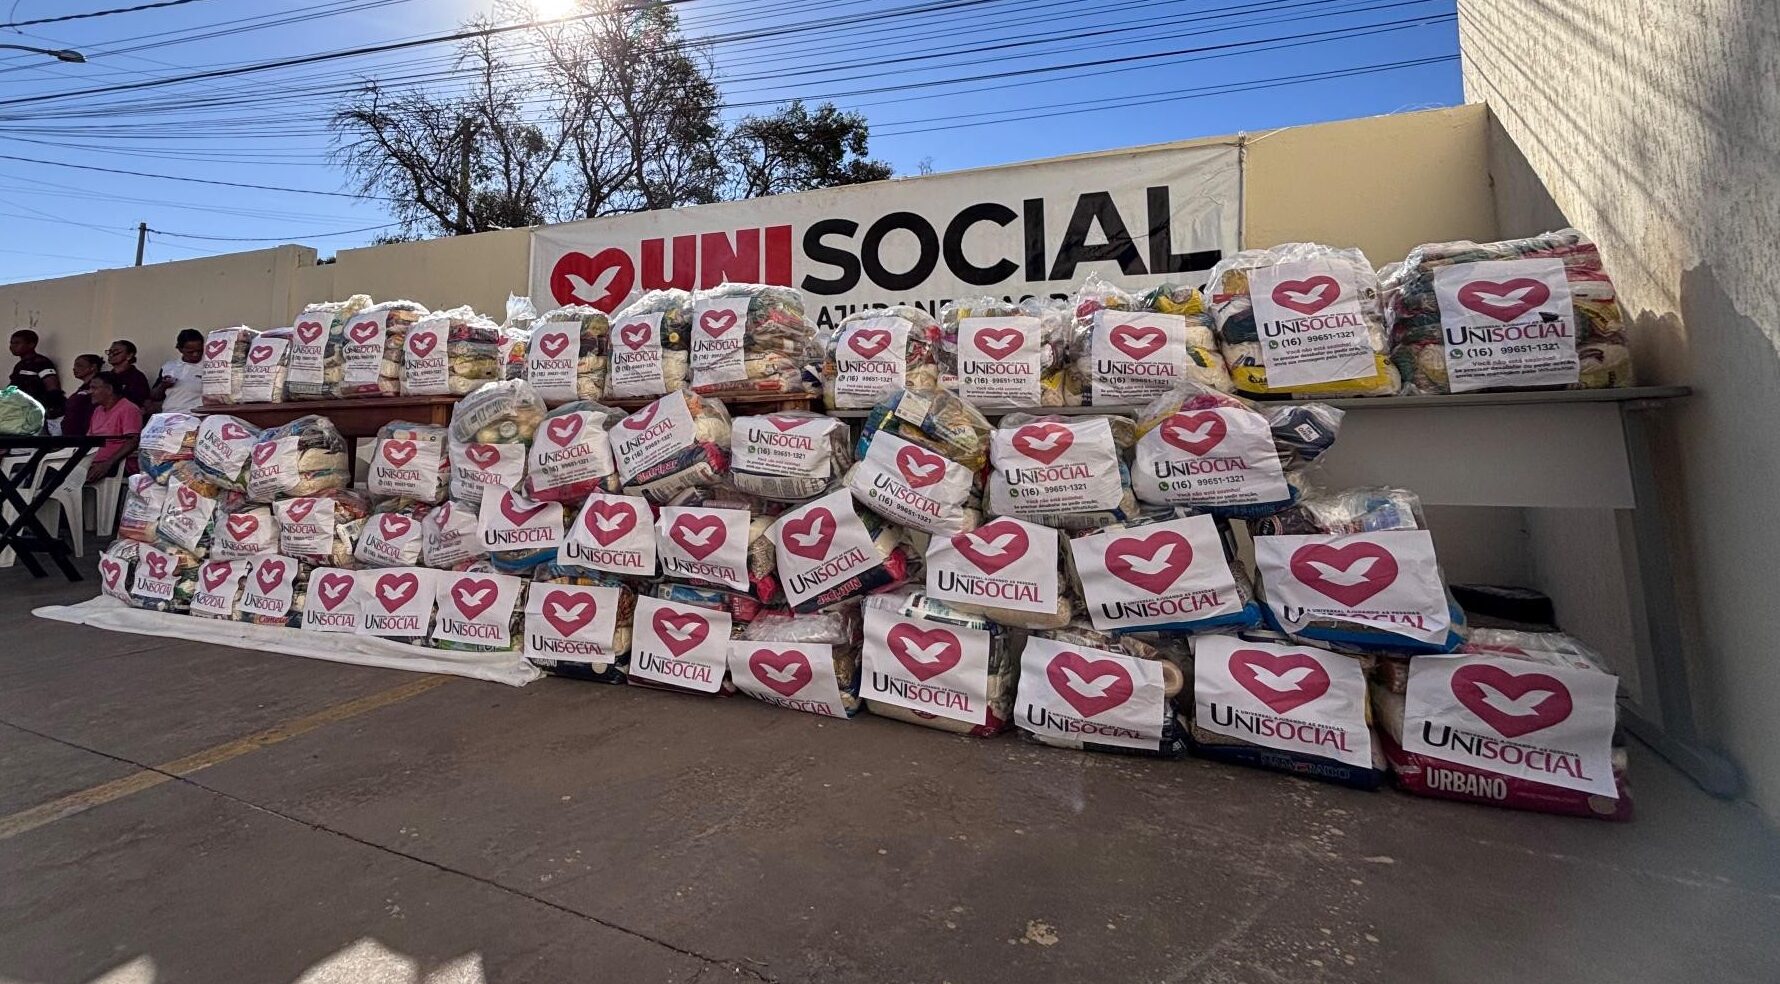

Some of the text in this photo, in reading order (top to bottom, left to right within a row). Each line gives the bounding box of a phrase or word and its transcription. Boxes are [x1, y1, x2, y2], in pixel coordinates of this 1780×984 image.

[1264, 313, 1363, 337] UNISOCIAL
[1446, 323, 1573, 345] UNISOCIAL
[693, 340, 740, 352] UNISOCIAL
[1281, 331, 1355, 349] (16) 99651-1321
[1467, 342, 1560, 358] (16) 99651-1321
[531, 360, 573, 370] UNISOCIAL
[614, 351, 660, 364] UNISOCIAL
[838, 360, 899, 374] UNISOCIAL
[964, 361, 1035, 375] UNISOCIAL
[1098, 360, 1178, 377] UNISOCIAL
[620, 419, 676, 455] UNISOCIAL
[748, 428, 815, 450] UNISOCIAL
[539, 443, 593, 466] UNISOCIAL
[377, 467, 421, 480] UNISOCIAL
[1005, 464, 1095, 486] UNISOCIAL
[1155, 459, 1252, 478] UNISOCIAL
[1021, 483, 1087, 497] (16) 99651-1321
[1171, 475, 1245, 490] (16) 99651-1321
[874, 472, 942, 518] UNISOCIAL
[878, 494, 893, 507] (16)
[366, 533, 401, 559] UNISOCIAL
[485, 528, 555, 545] UNISOCIAL
[567, 542, 645, 568] UNISOCIAL
[664, 556, 740, 582] UNISOCIAL
[789, 549, 870, 594] UNISOCIAL
[938, 570, 1044, 603] UNISOCIAL
[245, 592, 283, 612] UNISOCIAL
[1101, 592, 1226, 619] UNISOCIAL
[307, 610, 356, 628] UNISOCIAL
[365, 614, 420, 630] UNISOCIAL
[442, 618, 503, 640] UNISOCIAL
[532, 634, 605, 656] UNISOCIAL
[639, 651, 712, 684] UNISOCIAL
[873, 671, 974, 713] UNISOCIAL
[1027, 704, 1145, 739] UNISOCIAL
[1210, 702, 1353, 752] UNISOCIAL
[1422, 720, 1593, 781] UNISOCIAL
[1426, 767, 1508, 800] URBANO
